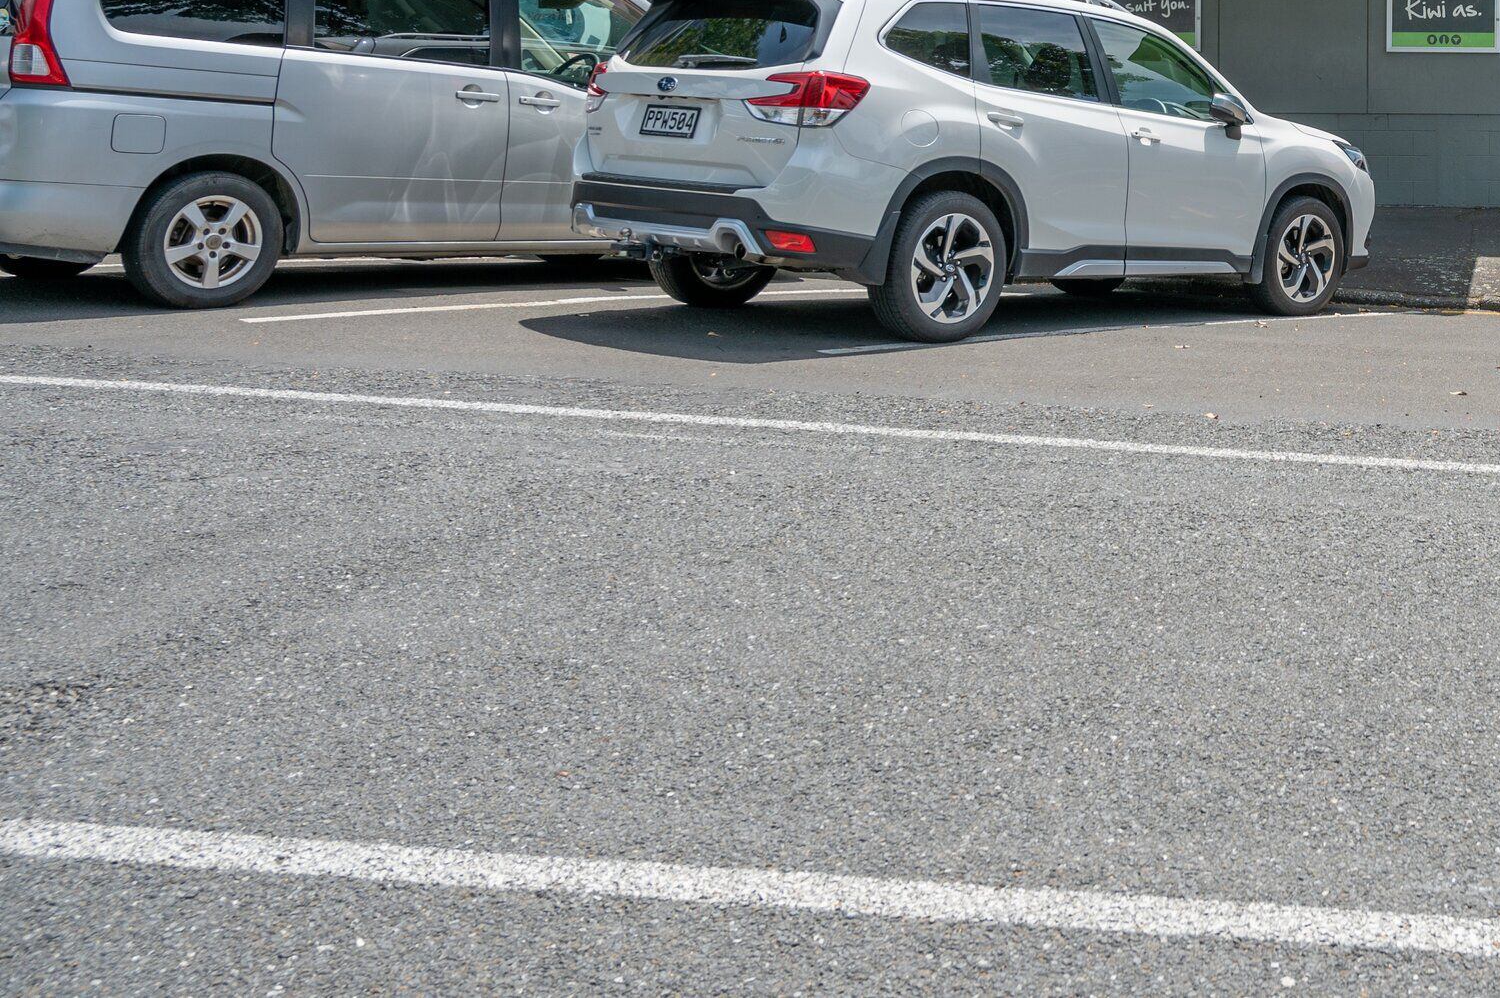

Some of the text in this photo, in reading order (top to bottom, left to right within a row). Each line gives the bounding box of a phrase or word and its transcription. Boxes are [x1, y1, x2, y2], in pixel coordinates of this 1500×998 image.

[1405, 0, 1482, 20] Kiwi as.
[644, 109, 696, 131] PPW504
